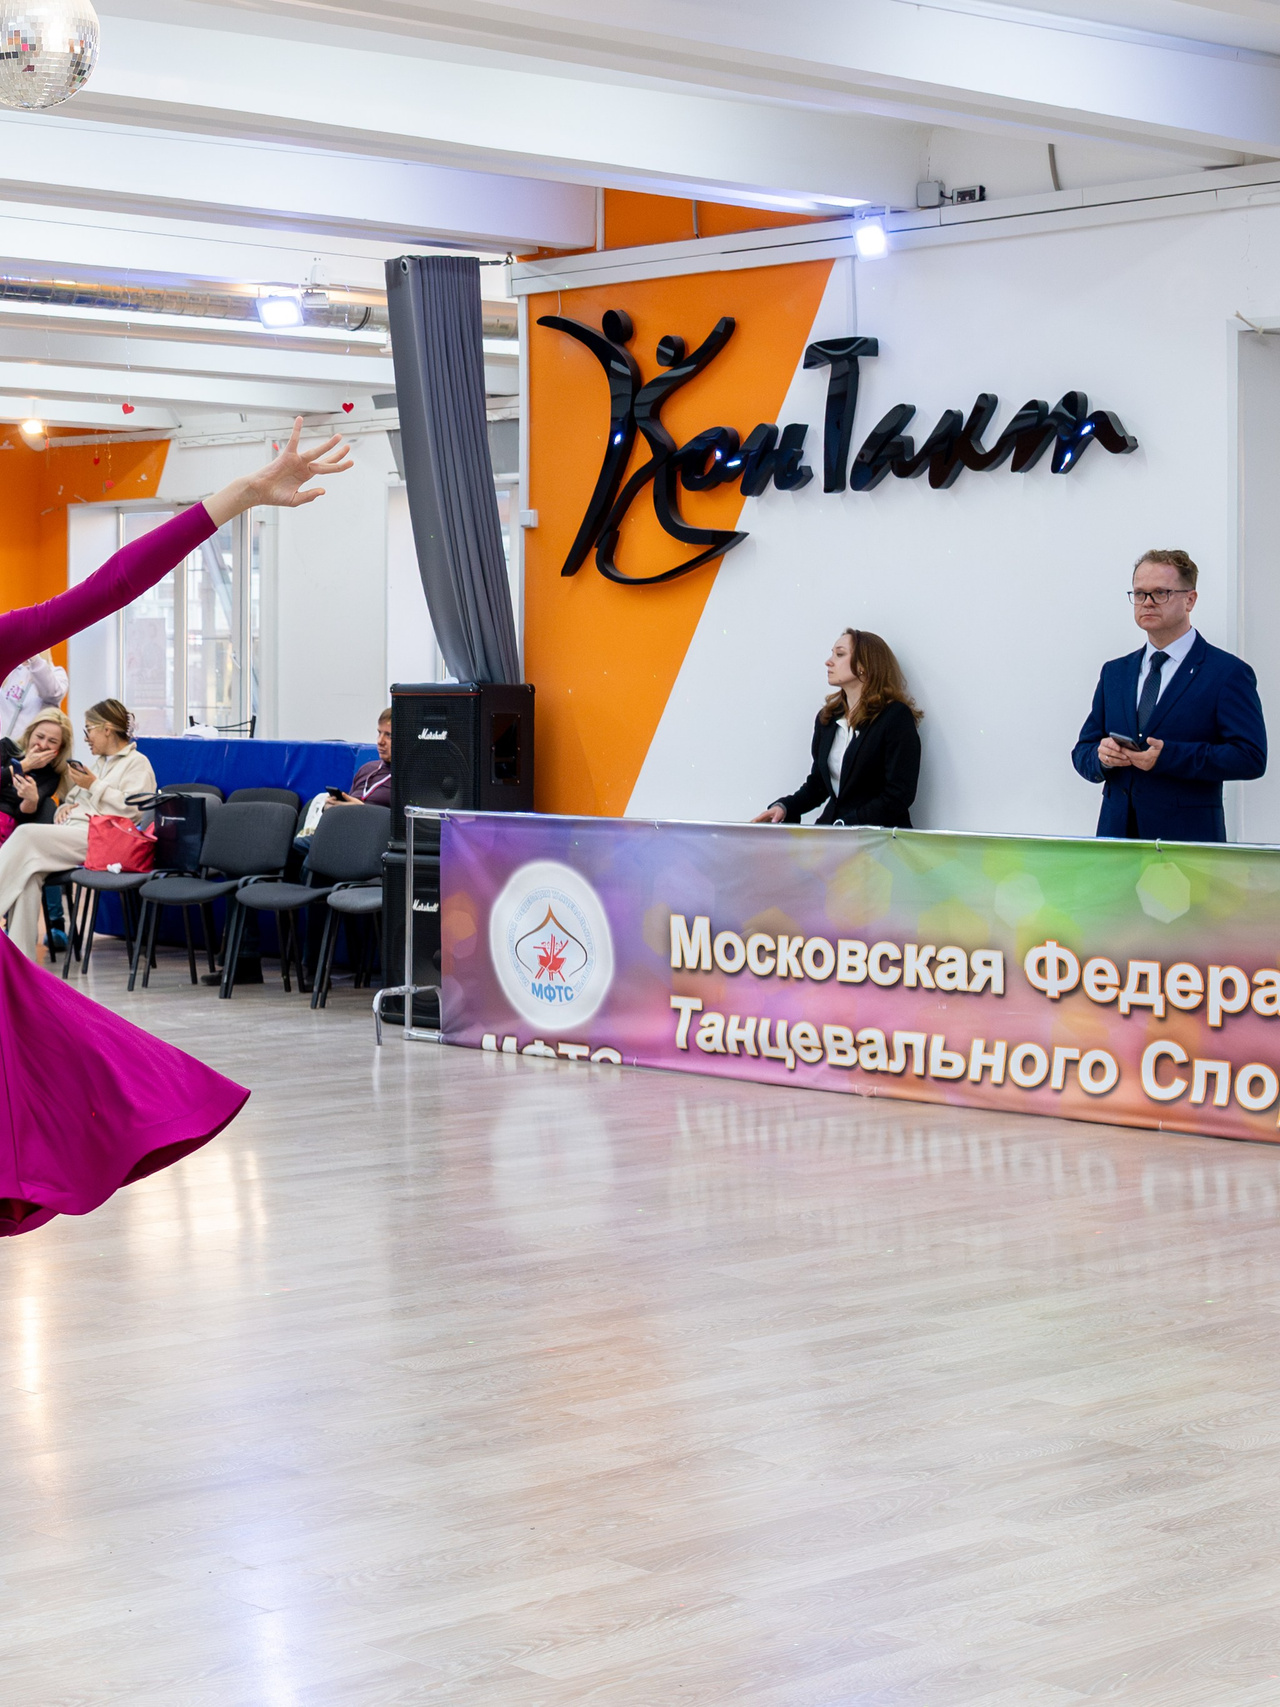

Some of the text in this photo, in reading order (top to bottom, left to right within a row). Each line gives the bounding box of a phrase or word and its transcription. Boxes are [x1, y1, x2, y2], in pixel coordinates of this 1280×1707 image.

[417, 727, 448, 740] Marshall
[412, 898, 439, 912] Marshall
[669, 913, 1005, 995] Московская
[1023, 939, 1280, 1027] Федера
[531, 982, 574, 1003] МФТС
[670, 995, 1280, 1129] Танцевального Спо
